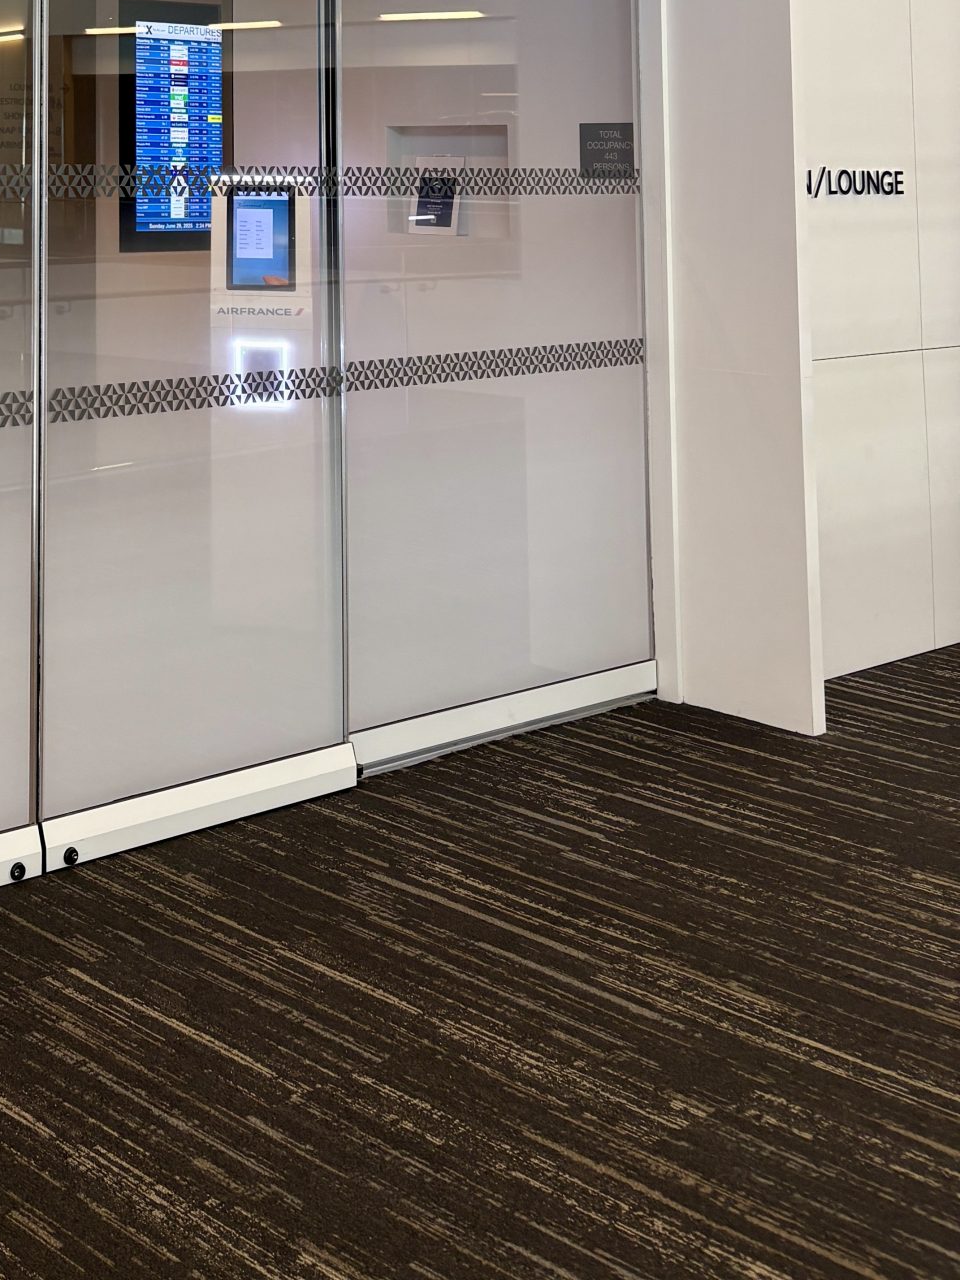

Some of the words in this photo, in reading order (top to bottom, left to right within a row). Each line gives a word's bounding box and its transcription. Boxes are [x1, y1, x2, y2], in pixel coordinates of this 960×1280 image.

[167, 25, 222, 38] DEPARTURES
[600, 130, 622, 139] TOTAL
[604, 152, 618, 160] 443
[593, 162, 630, 171] PERSONS
[217, 307, 292, 317] AIRFRANCE
